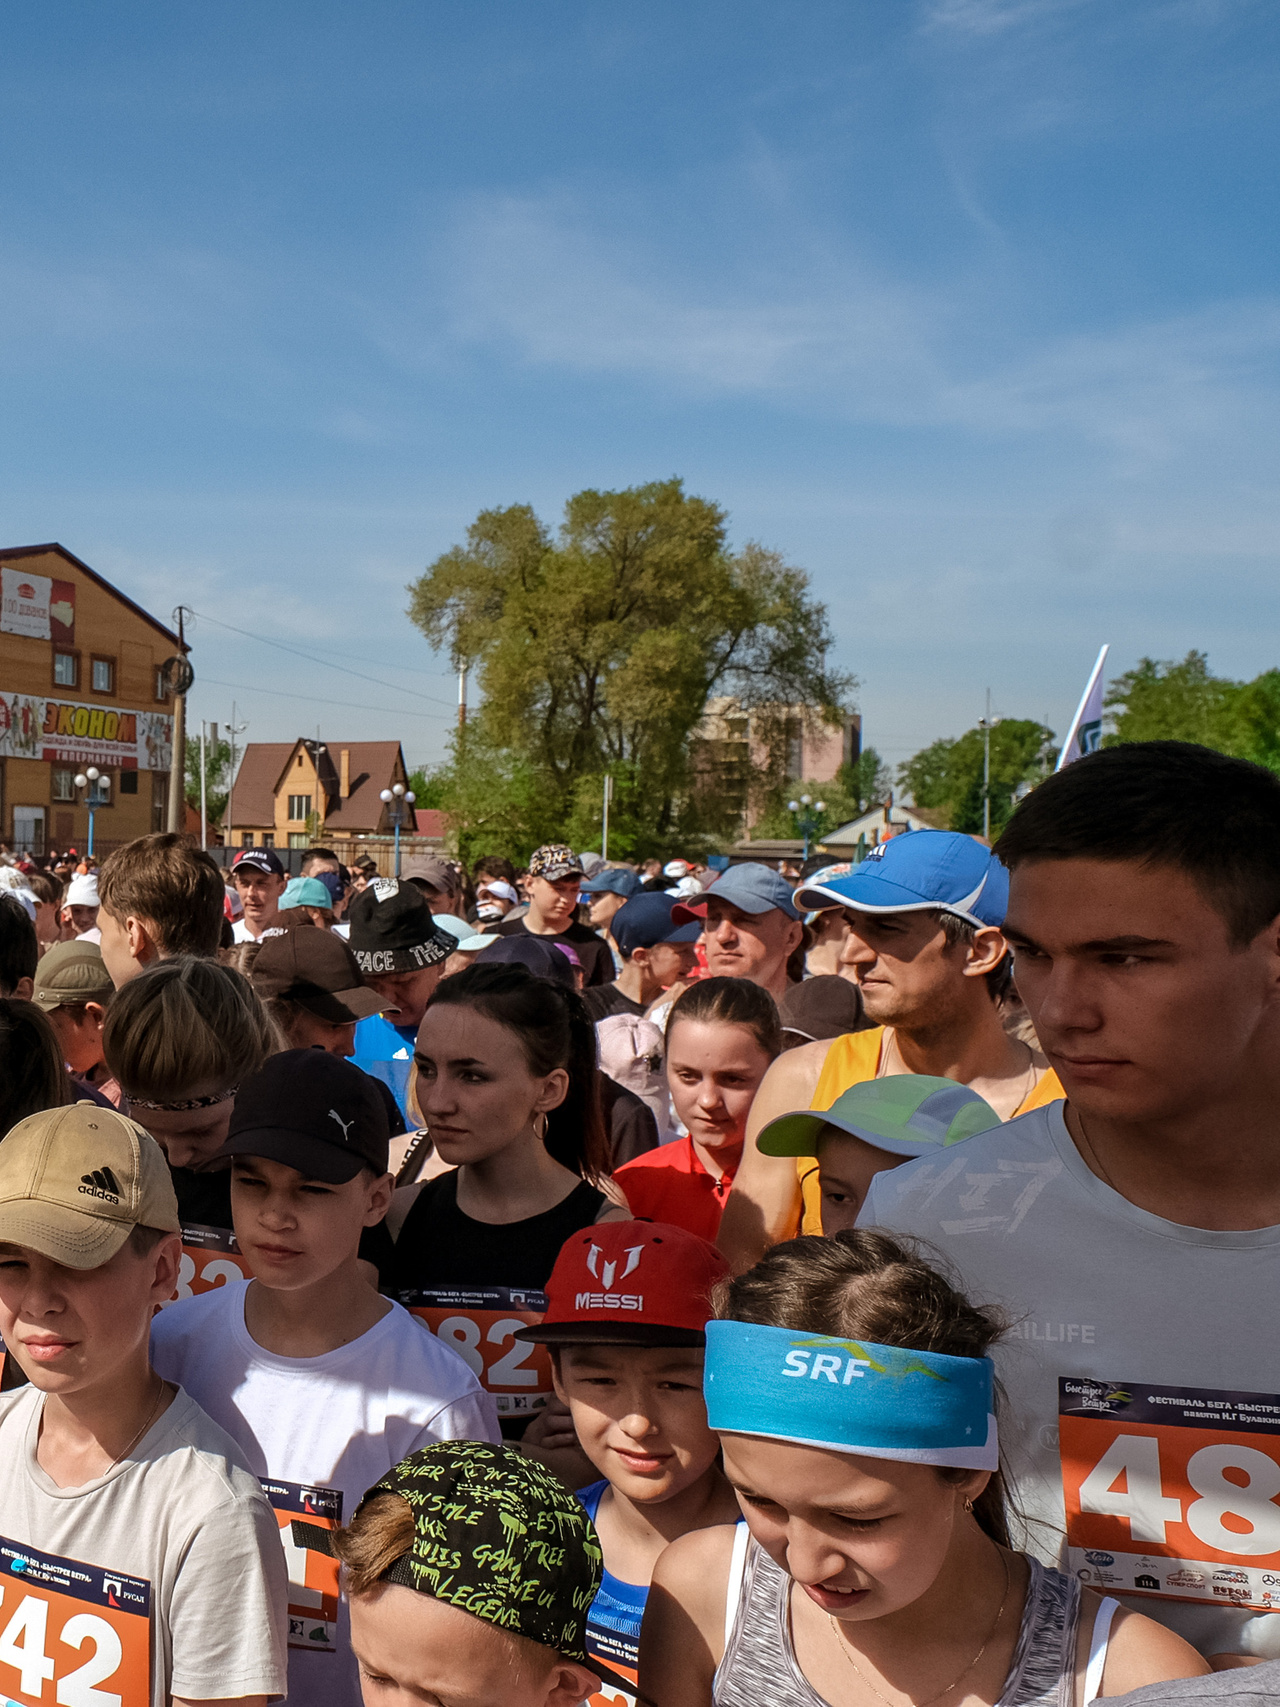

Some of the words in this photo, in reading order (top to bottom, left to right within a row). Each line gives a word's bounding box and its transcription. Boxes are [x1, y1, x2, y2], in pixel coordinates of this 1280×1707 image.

[43, 702, 137, 744] ЭКОНОМ
[56, 749, 123, 766] ГИПЕРМАРКЕТ
[77, 1185, 119, 1205] adidas
[575, 1292, 643, 1311] MESSI
[412, 1315, 538, 1386] 82
[781, 1350, 871, 1385] SRF
[1148, 1395, 1205, 1408] ФЕСТИВАЛЬ
[1207, 1400, 1232, 1410] БЕГА
[1184, 1410, 1220, 1420] памяти
[123, 1591, 145, 1604] РУСАЛ
